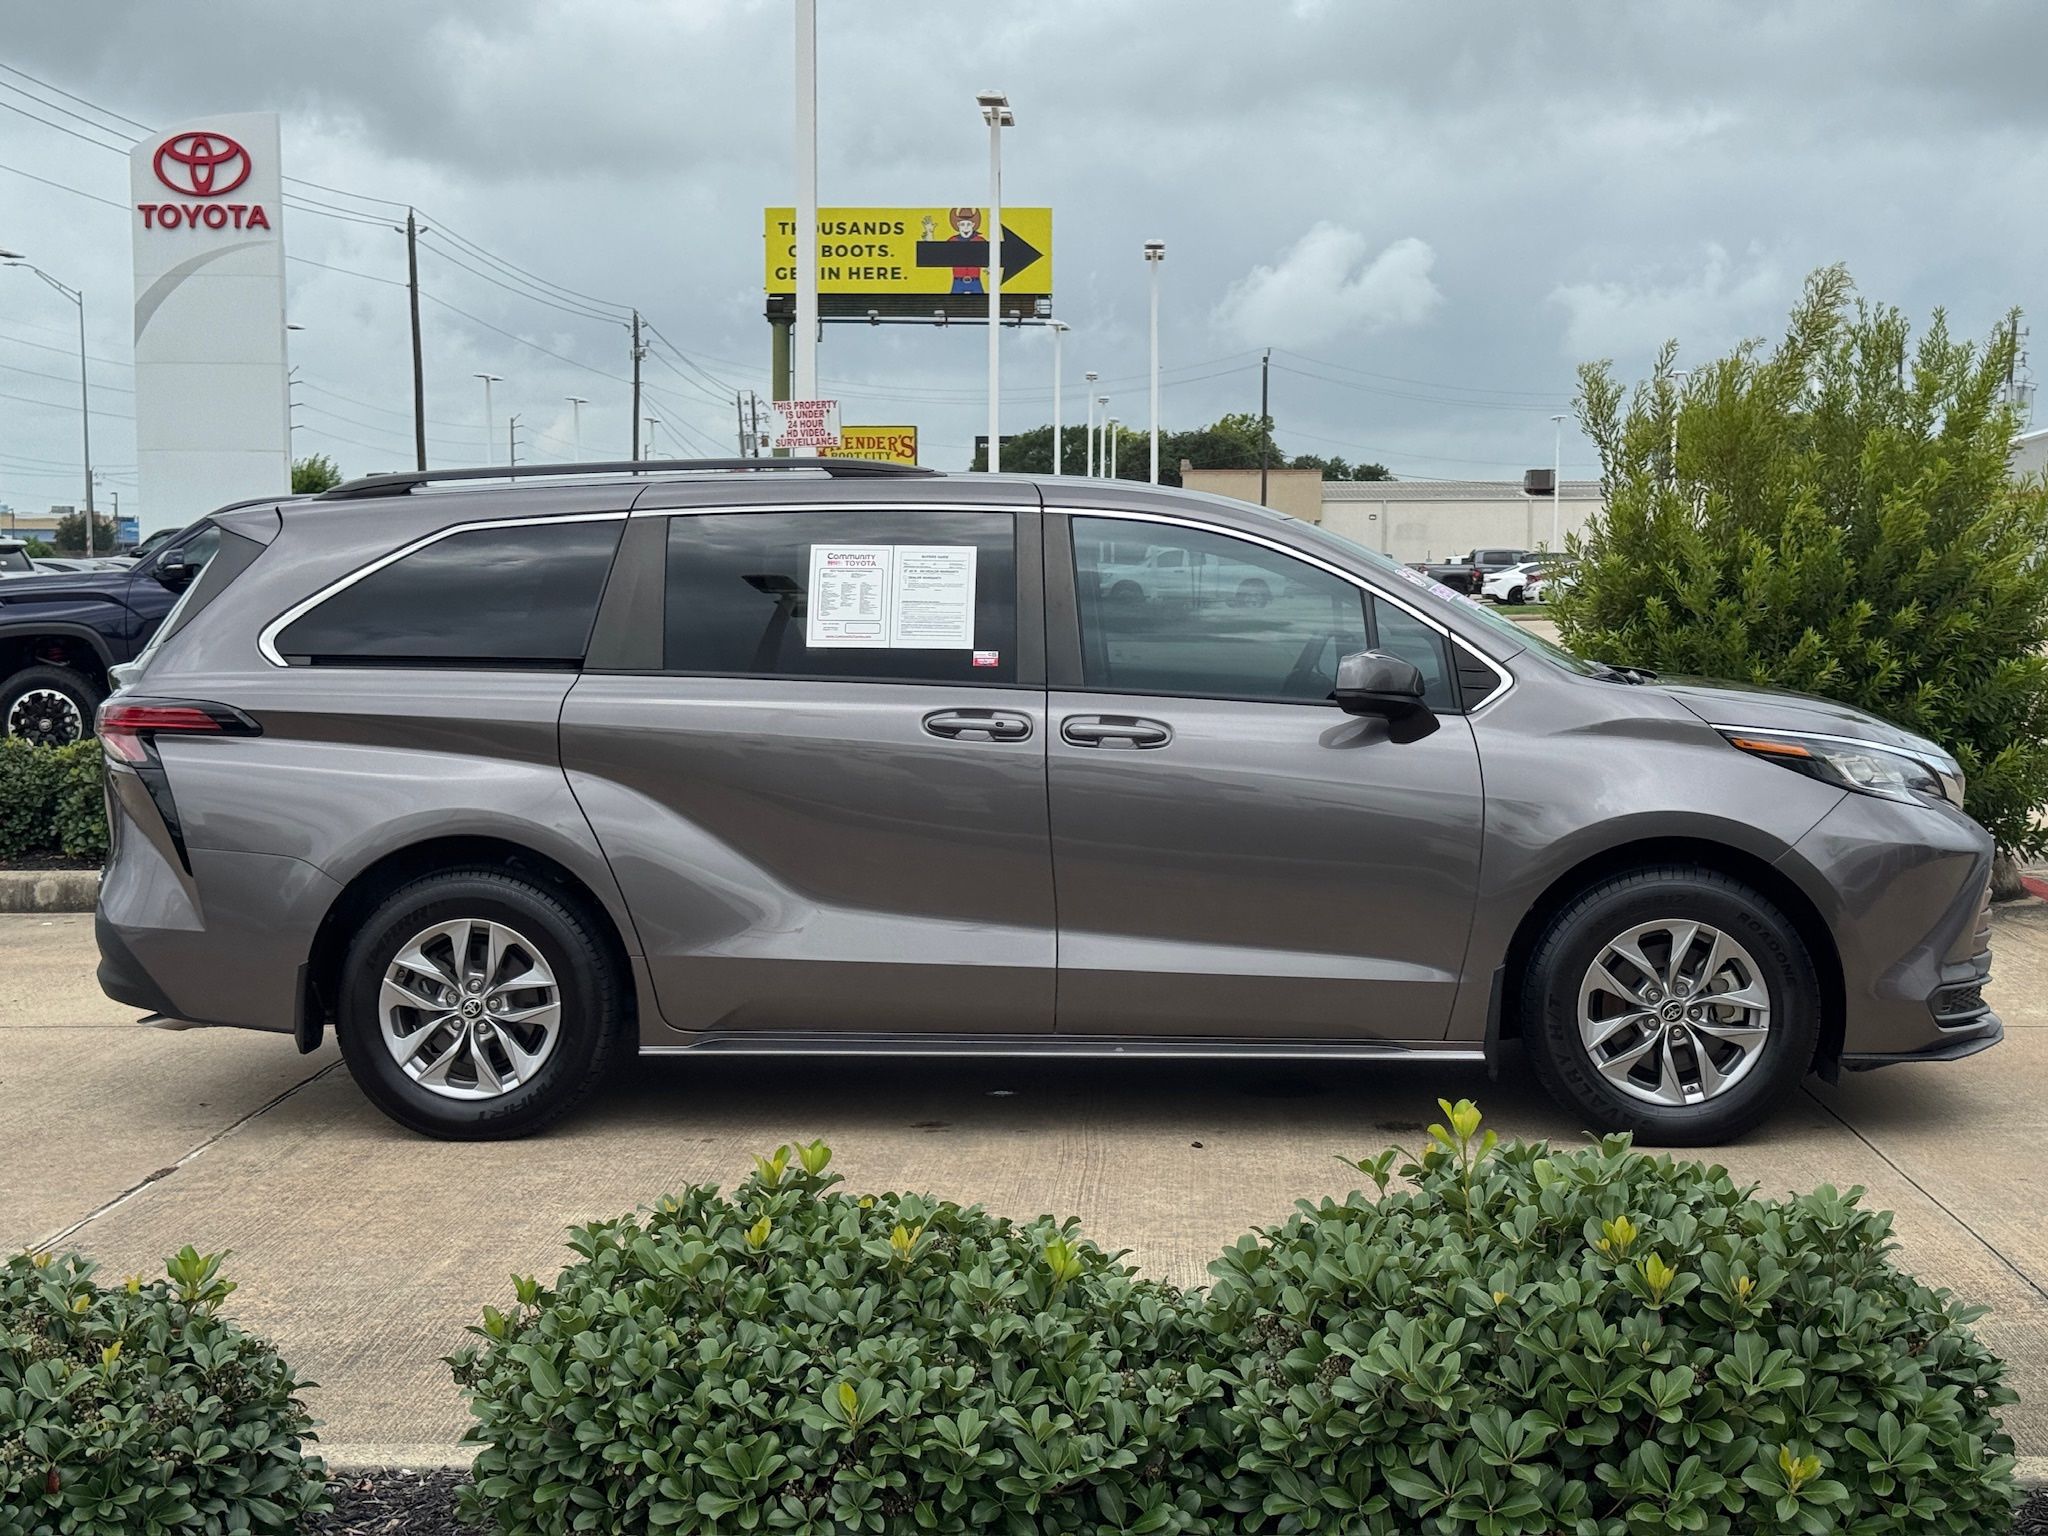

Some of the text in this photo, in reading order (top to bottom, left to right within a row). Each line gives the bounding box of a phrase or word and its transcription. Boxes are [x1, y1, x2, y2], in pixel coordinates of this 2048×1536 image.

[138, 204, 271, 229] TOYOTA
[778, 222, 905, 235] TUSANDS
[821, 244, 895, 258] BOOTS.
[775, 267, 908, 280] GE IN HERE.
[772, 400, 838, 411] THIS PROPERTY
[785, 410, 825, 419] IS UNDER
[787, 419, 824, 429] 24 HOUR
[786, 428, 826, 438] HD VIDEO
[775, 437, 839, 447] SURVEILLANCE
[818, 434, 916, 458] ENDER'S
[864, 452, 891, 460] CITY
